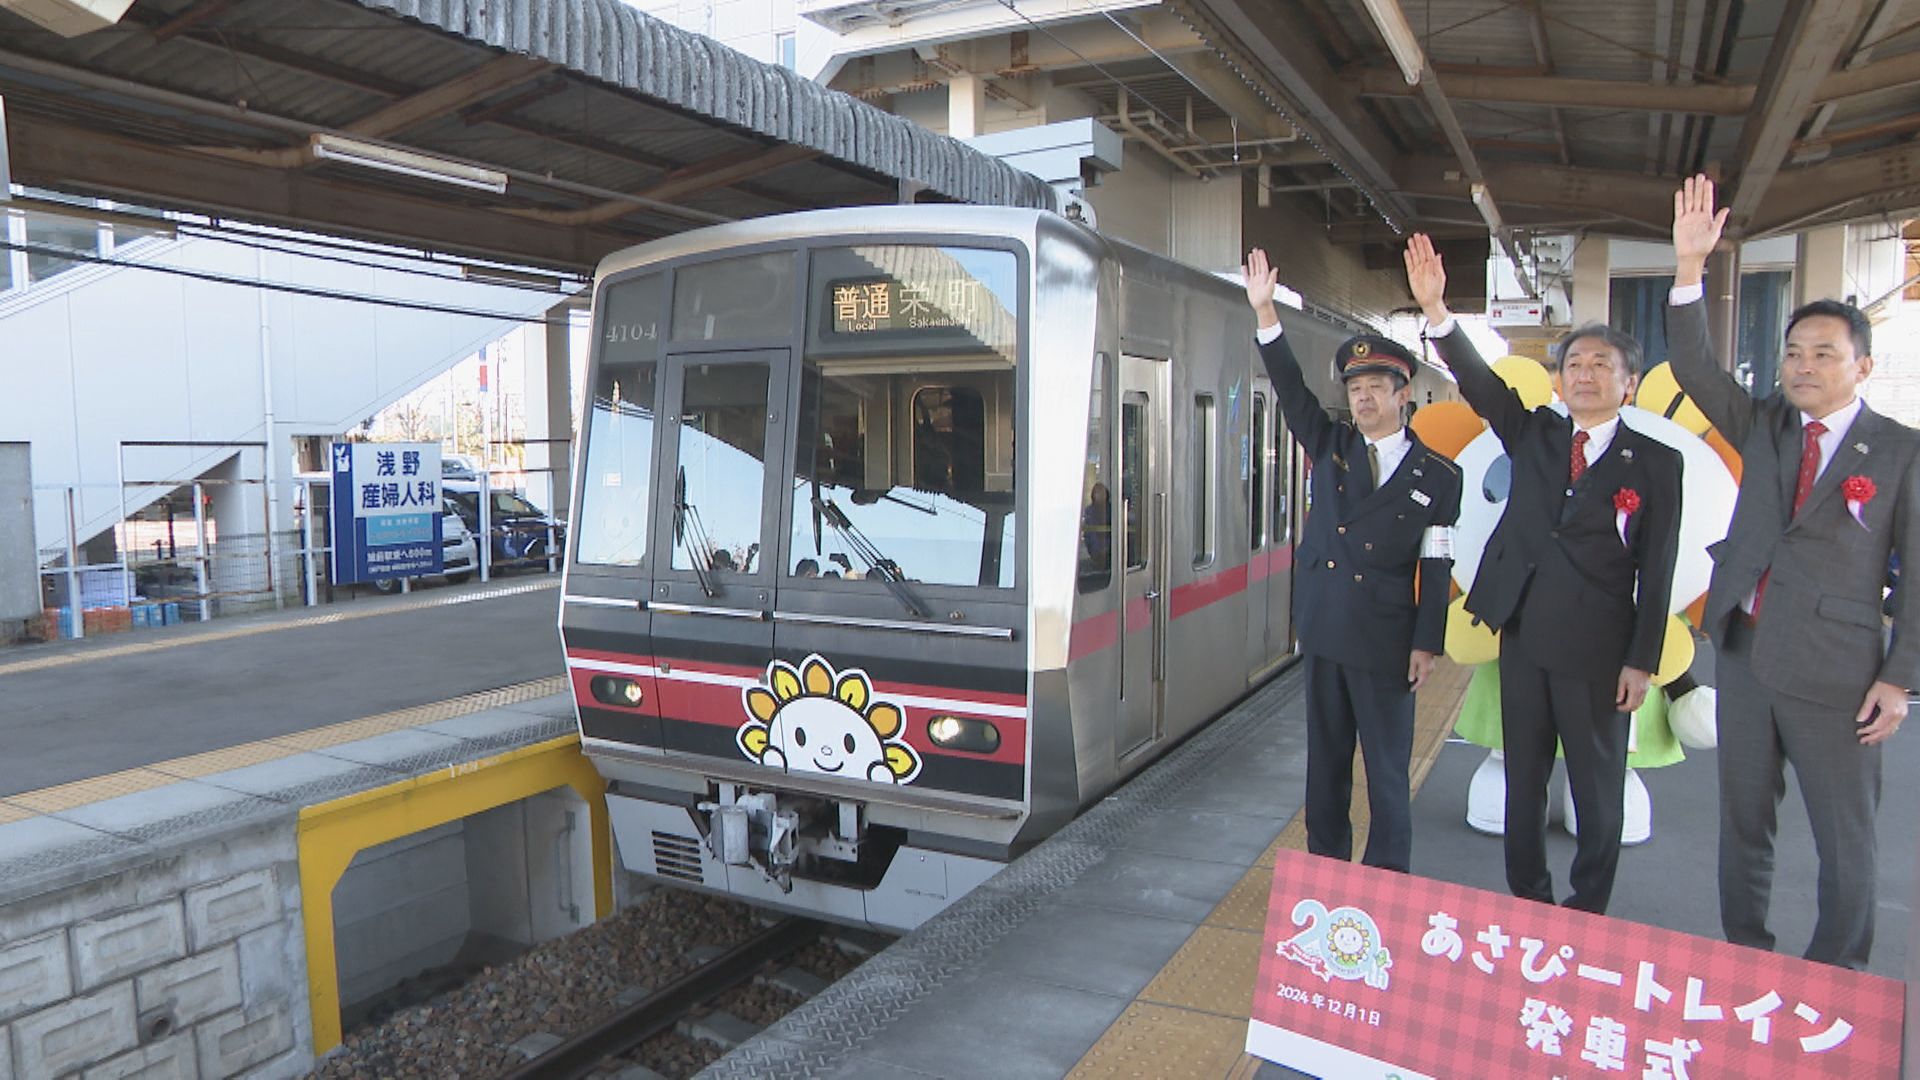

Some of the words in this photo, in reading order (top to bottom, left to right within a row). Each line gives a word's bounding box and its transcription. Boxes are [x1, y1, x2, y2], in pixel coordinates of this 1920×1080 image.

[834, 283, 890, 320] 普通
[900, 279, 980, 317] 栄町
[606, 322, 657, 342] 4104
[848, 319, 876, 331] Local
[377, 451, 420, 477] 浅野
[362, 481, 435, 508] 産婦人科
[1421, 911, 1853, 1052] あさぴートレイン
[1519, 997, 1702, 1080] 発車式
